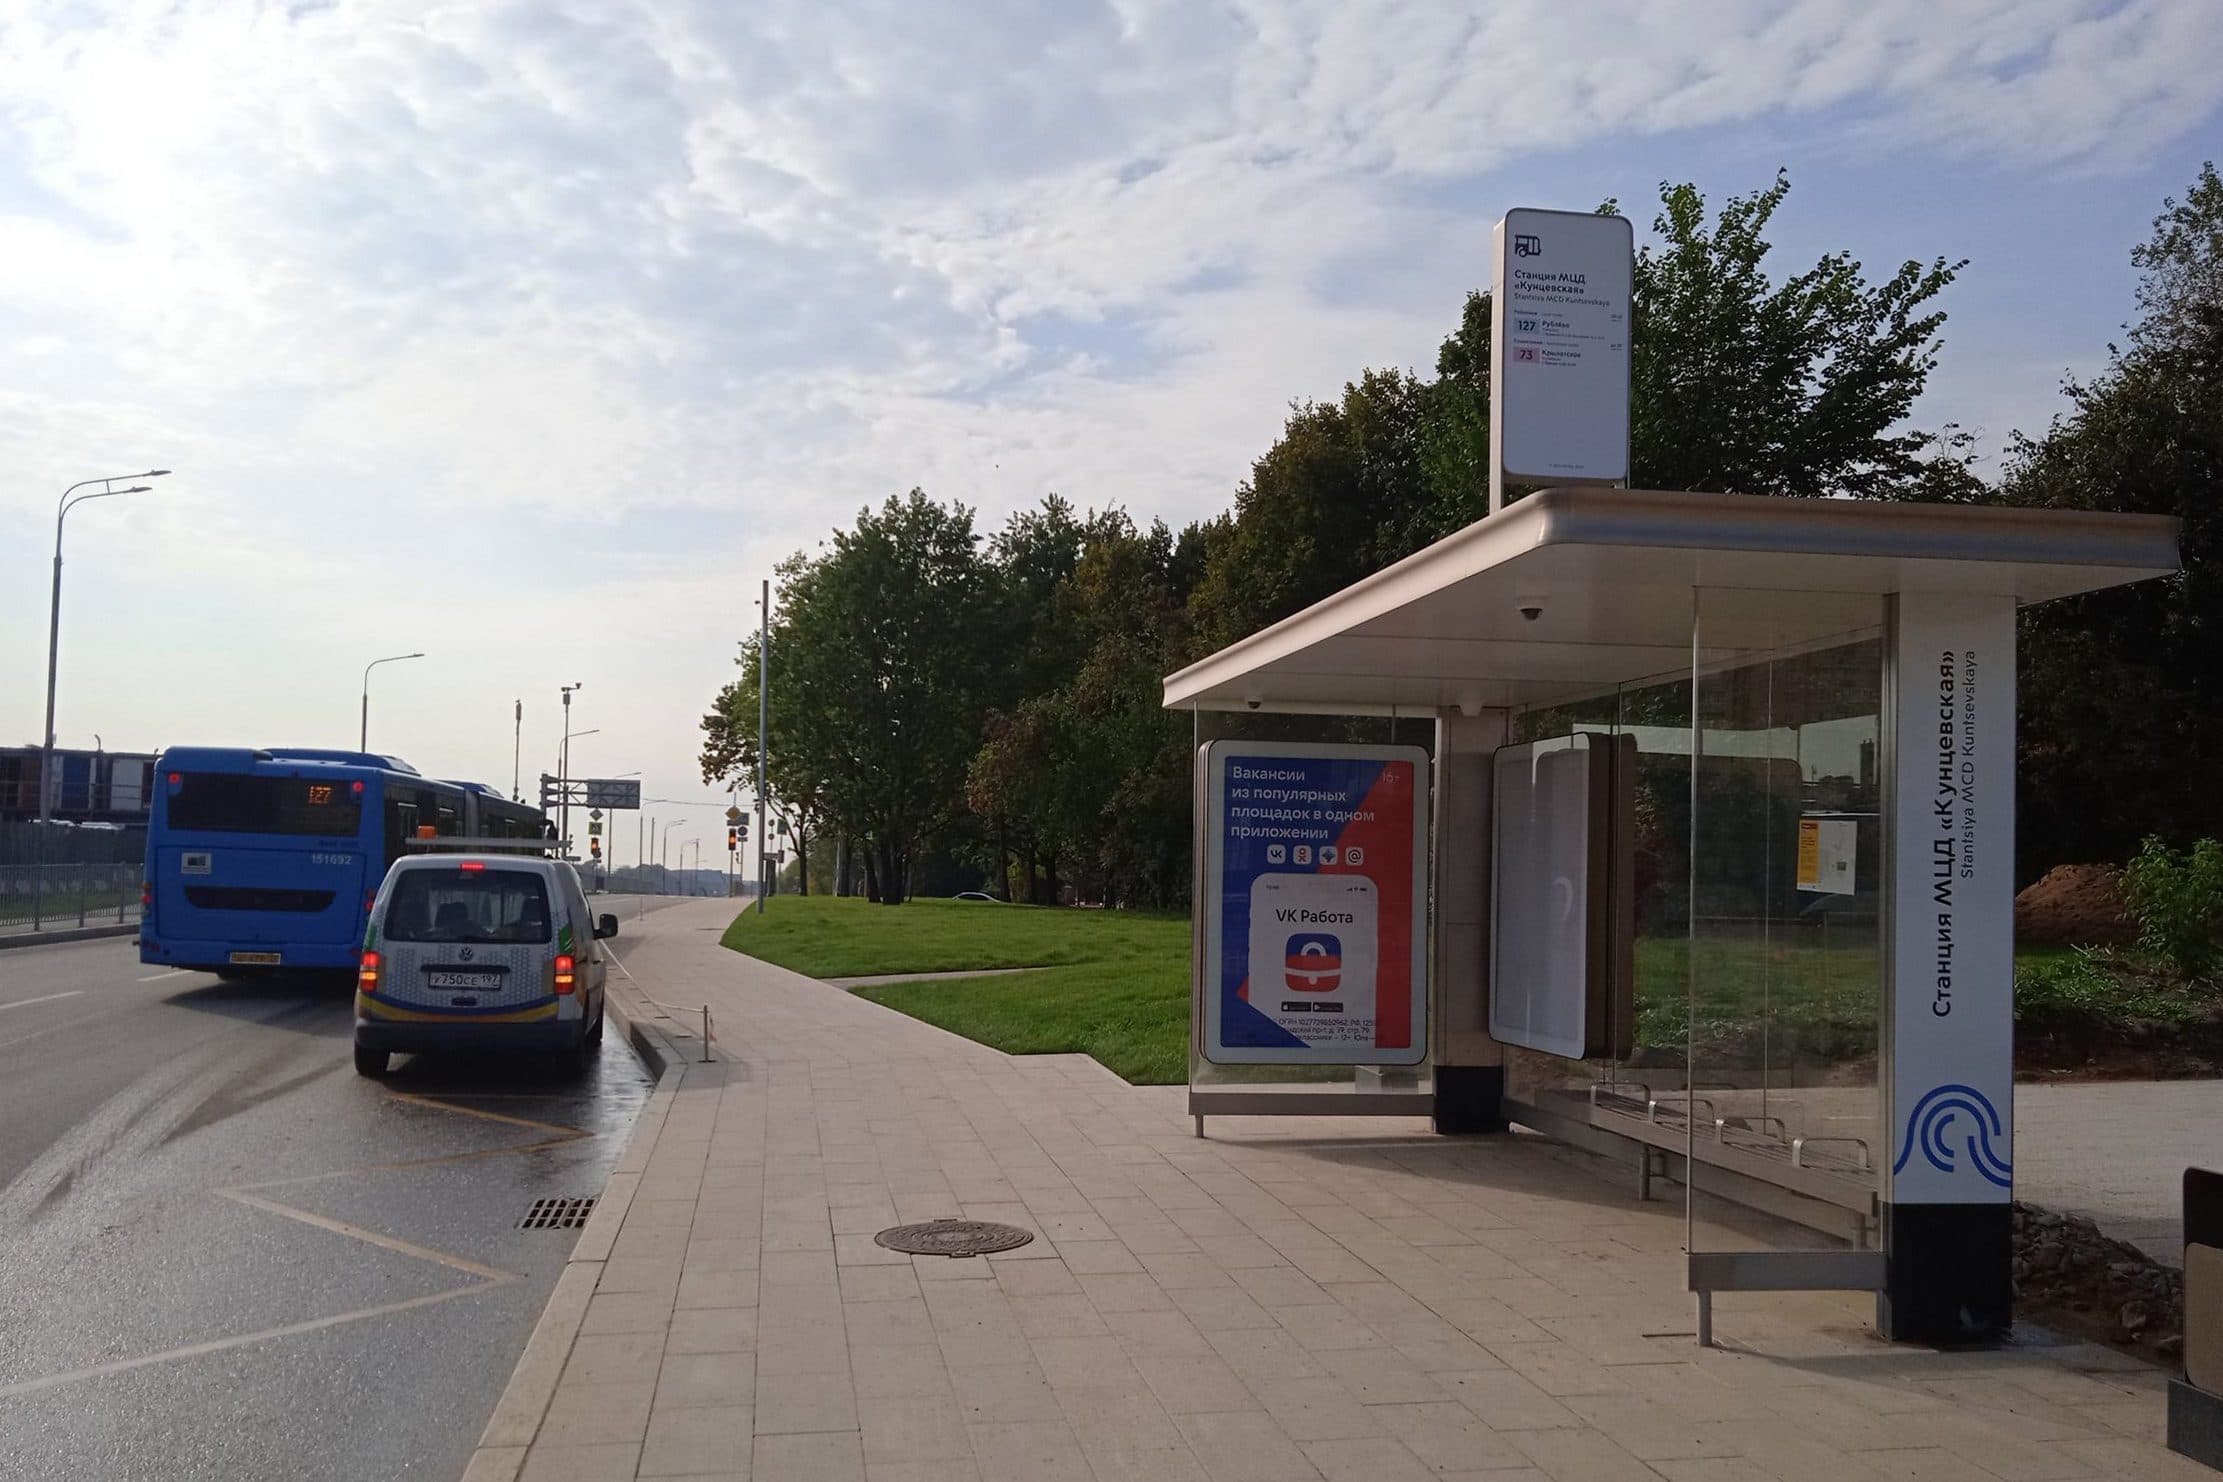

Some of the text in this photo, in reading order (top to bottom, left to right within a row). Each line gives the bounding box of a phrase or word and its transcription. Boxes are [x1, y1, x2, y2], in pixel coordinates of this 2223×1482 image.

[1514, 269, 1586, 284] Станция МЦД
[1514, 281, 1585, 295] «Кунцевская»
[1518, 321, 1536, 332] 127
[1519, 349, 1534, 361] 73
[1232, 765, 1306, 781] Вакансии
[1961, 651, 1978, 879] Stantsiya MCD Kuntsevskaya
[308, 786, 333, 804] 127
[1231, 787, 1348, 804] из популярных
[1231, 806, 1376, 824] площадок в одном
[1230, 825, 1330, 840] приложении
[1932, 651, 1958, 1018] Станция МЦД «Кунцевская»
[1275, 908, 1354, 924] VK Работа
